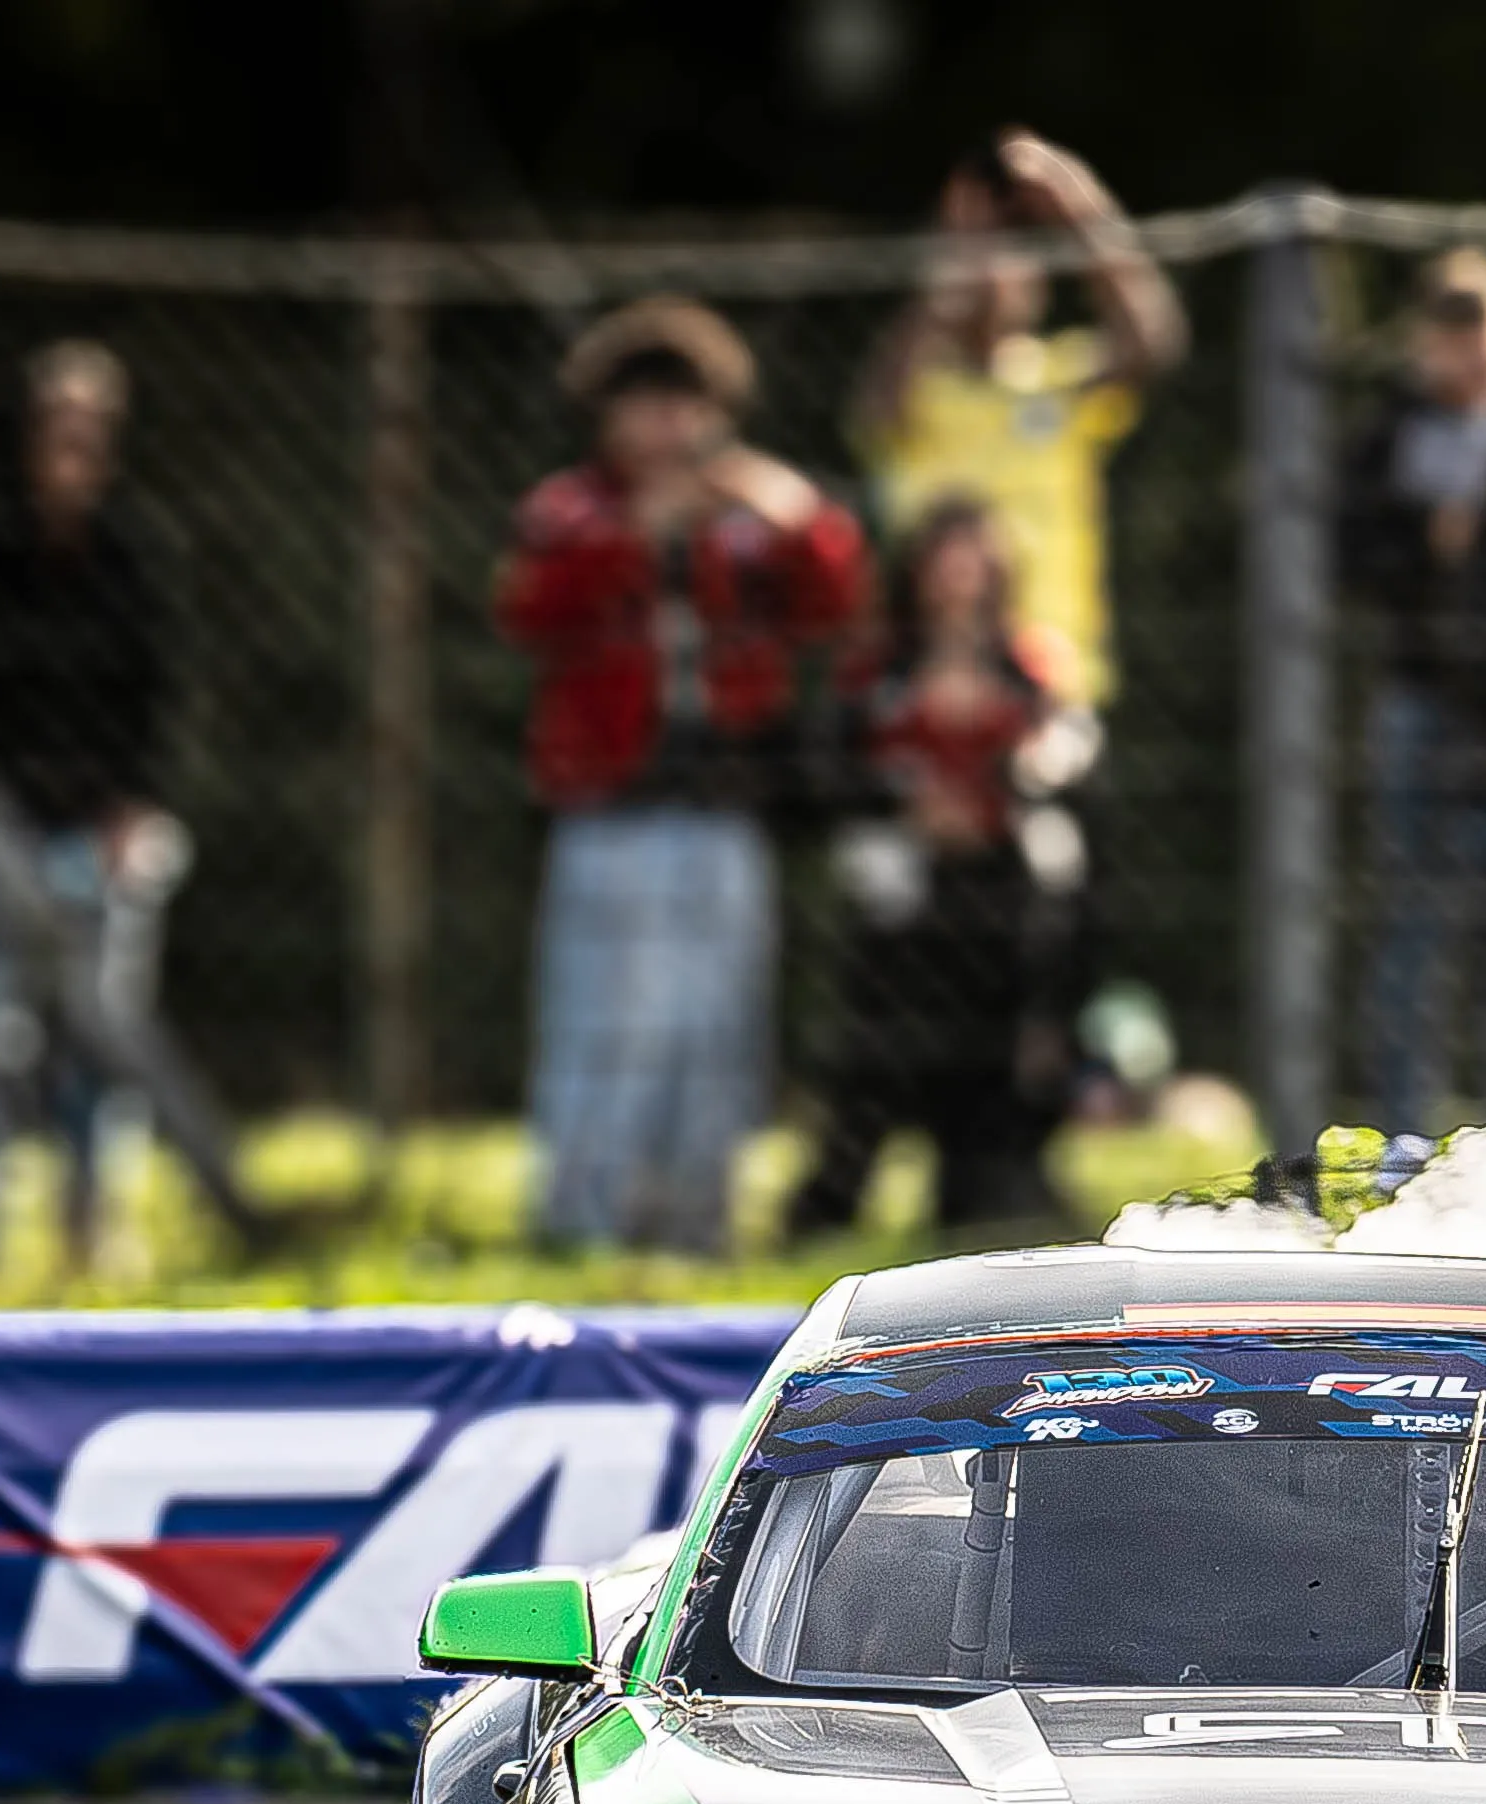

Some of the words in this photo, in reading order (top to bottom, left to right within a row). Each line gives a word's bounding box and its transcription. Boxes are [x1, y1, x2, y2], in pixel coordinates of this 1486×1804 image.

[1016, 1380, 1204, 1410] SHOWDOWN
[1033, 1368, 1192, 1393] 130
[16, 1403, 746, 1684] FA
